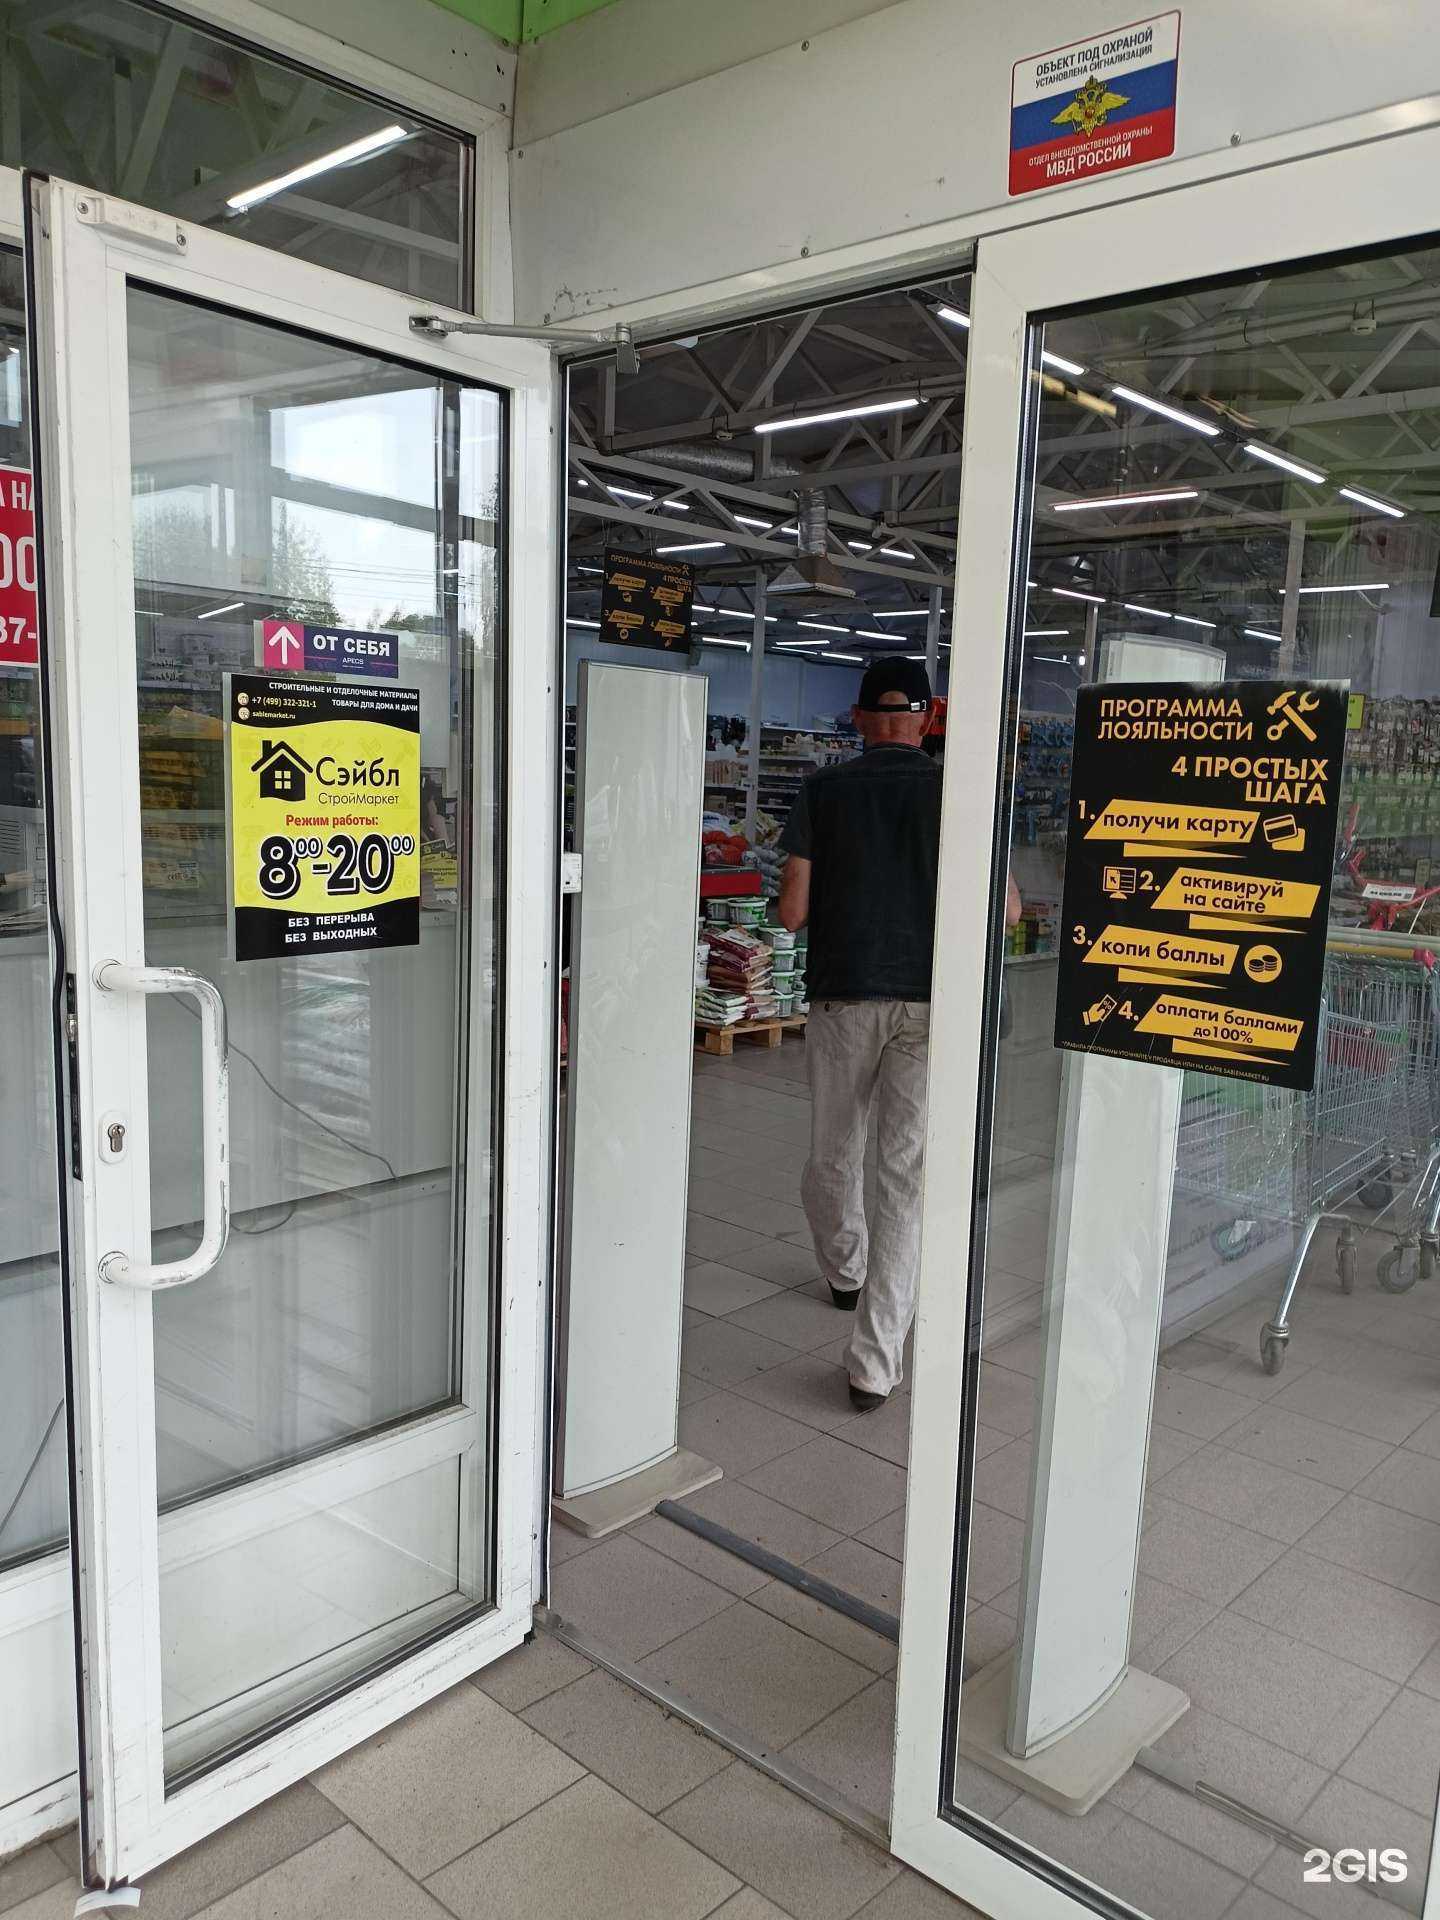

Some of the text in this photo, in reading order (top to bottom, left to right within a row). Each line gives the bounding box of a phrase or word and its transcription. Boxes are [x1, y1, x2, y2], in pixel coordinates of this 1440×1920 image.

[1036, 27, 1153, 77] ОБЪЕКТ ПОД ОХРАНОЙ
[1035, 44, 1153, 88] УСТАНОВЛЕНА СИГНАЛИЗАЦИЯ
[1028, 126, 1153, 167] ОТДЕЛ ВНЕВЕДОМСТВЕННОЙ ОХРАНЫ
[1047, 141, 1132, 178] МВД РОССИИ
[313, 634, 390, 657] ОТ СЕБЯ
[252, 696, 262, 704] +7
[269, 682, 418, 700] СТРОИТЕЛЬНЫЕ И ОТДЕЛОЧНЫЕ МАТЕРИАЛЫ
[332, 699, 359, 708] ТОВАРЫ
[360, 701, 375, 710] ДЛЯ
[375, 702, 394, 711] ДОМА
[400, 704, 418, 712] ДАЧИ
[1100, 698, 1243, 717] ПРОГРАММА
[1098, 720, 1254, 742] ЛОЯЛЬНОСТИ
[316, 756, 400, 788] Сэйбл
[1171, 756, 1329, 781] 4 ПРОСТЫХ
[318, 792, 400, 807] СтройМаркет
[1245, 781, 1326, 805] ШАГА
[1077, 800, 1096, 820] 1.
[286, 814, 379, 829] Режим работы:
[1103, 813, 1254, 839] получи карту
[1140, 870, 1160, 891] 2.
[1180, 873, 1284, 900] активируй
[1183, 892, 1266, 914] на сайте
[288, 912, 375, 928] БЕЗ ПЕРЕРЫВА
[285, 927, 377, 943] БЕЗ ВЫХОДНЫХ
[1073, 926, 1093, 946] 3.
[1101, 940, 1225, 967] копи баллы
[1118, 1001, 1140, 1021] 4.
[1155, 1002, 1298, 1035] оплати баллами
